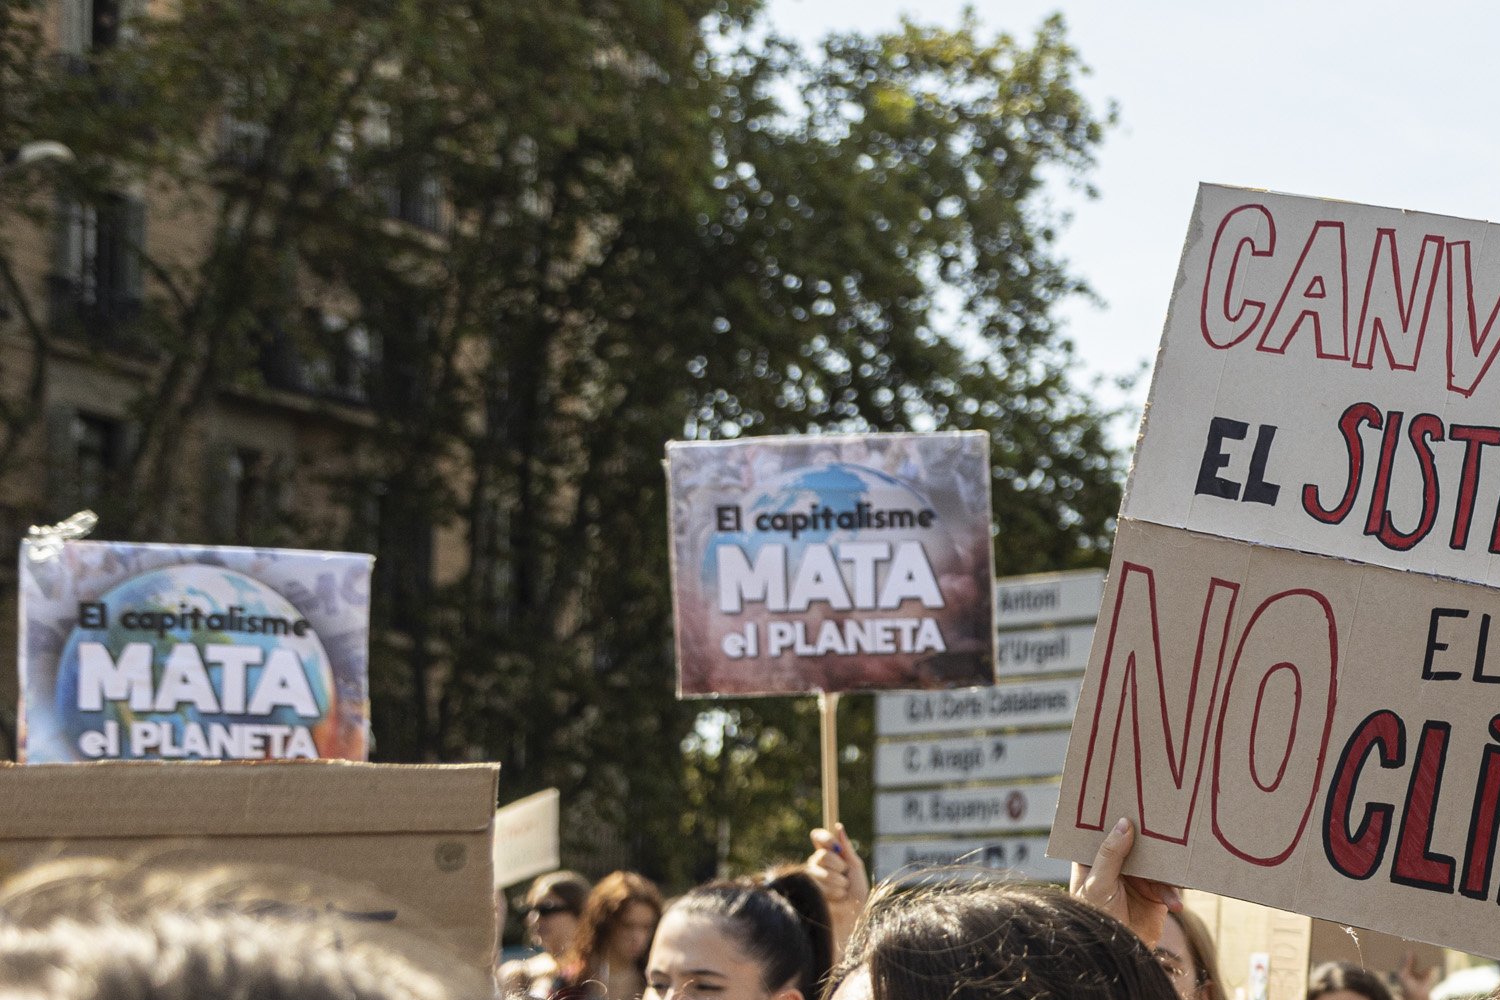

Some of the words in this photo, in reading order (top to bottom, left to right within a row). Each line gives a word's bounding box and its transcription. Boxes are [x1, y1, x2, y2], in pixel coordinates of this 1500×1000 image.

[1195, 416, 1281, 506] EL
[715, 506, 743, 532] El
[755, 505, 935, 540] capitalisme
[716, 540, 945, 614] MATA
[78, 602, 107, 631] El
[121, 603, 312, 639] capitalisme
[722, 627, 758, 659] el
[768, 618, 946, 659] PLANETA
[77, 642, 320, 718] MATA
[78, 721, 119, 758] el
[131, 722, 319, 759] PLANETA
[1075, 561, 1338, 867] NO
